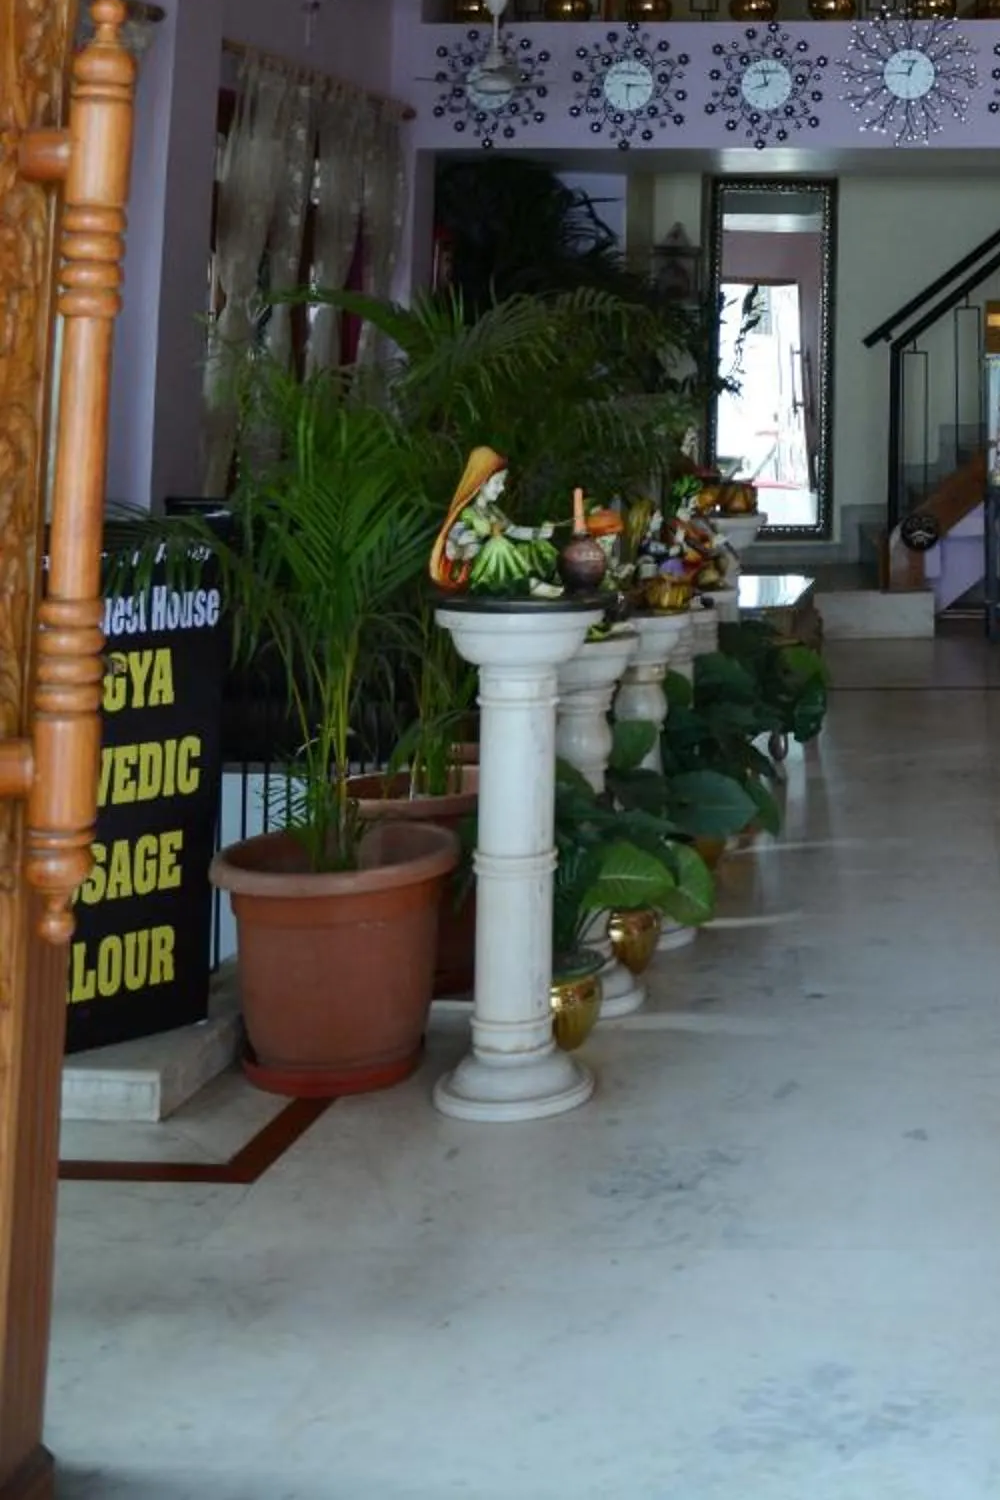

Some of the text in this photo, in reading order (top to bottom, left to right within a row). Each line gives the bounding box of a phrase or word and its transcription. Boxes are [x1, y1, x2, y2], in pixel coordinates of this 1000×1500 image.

[99, 585, 220, 635] uest House
[103, 647, 175, 712] GYA
[97, 735, 201, 807] VEDIC
[72, 829, 183, 905] SAGE
[66, 925, 175, 1004] LOUR
